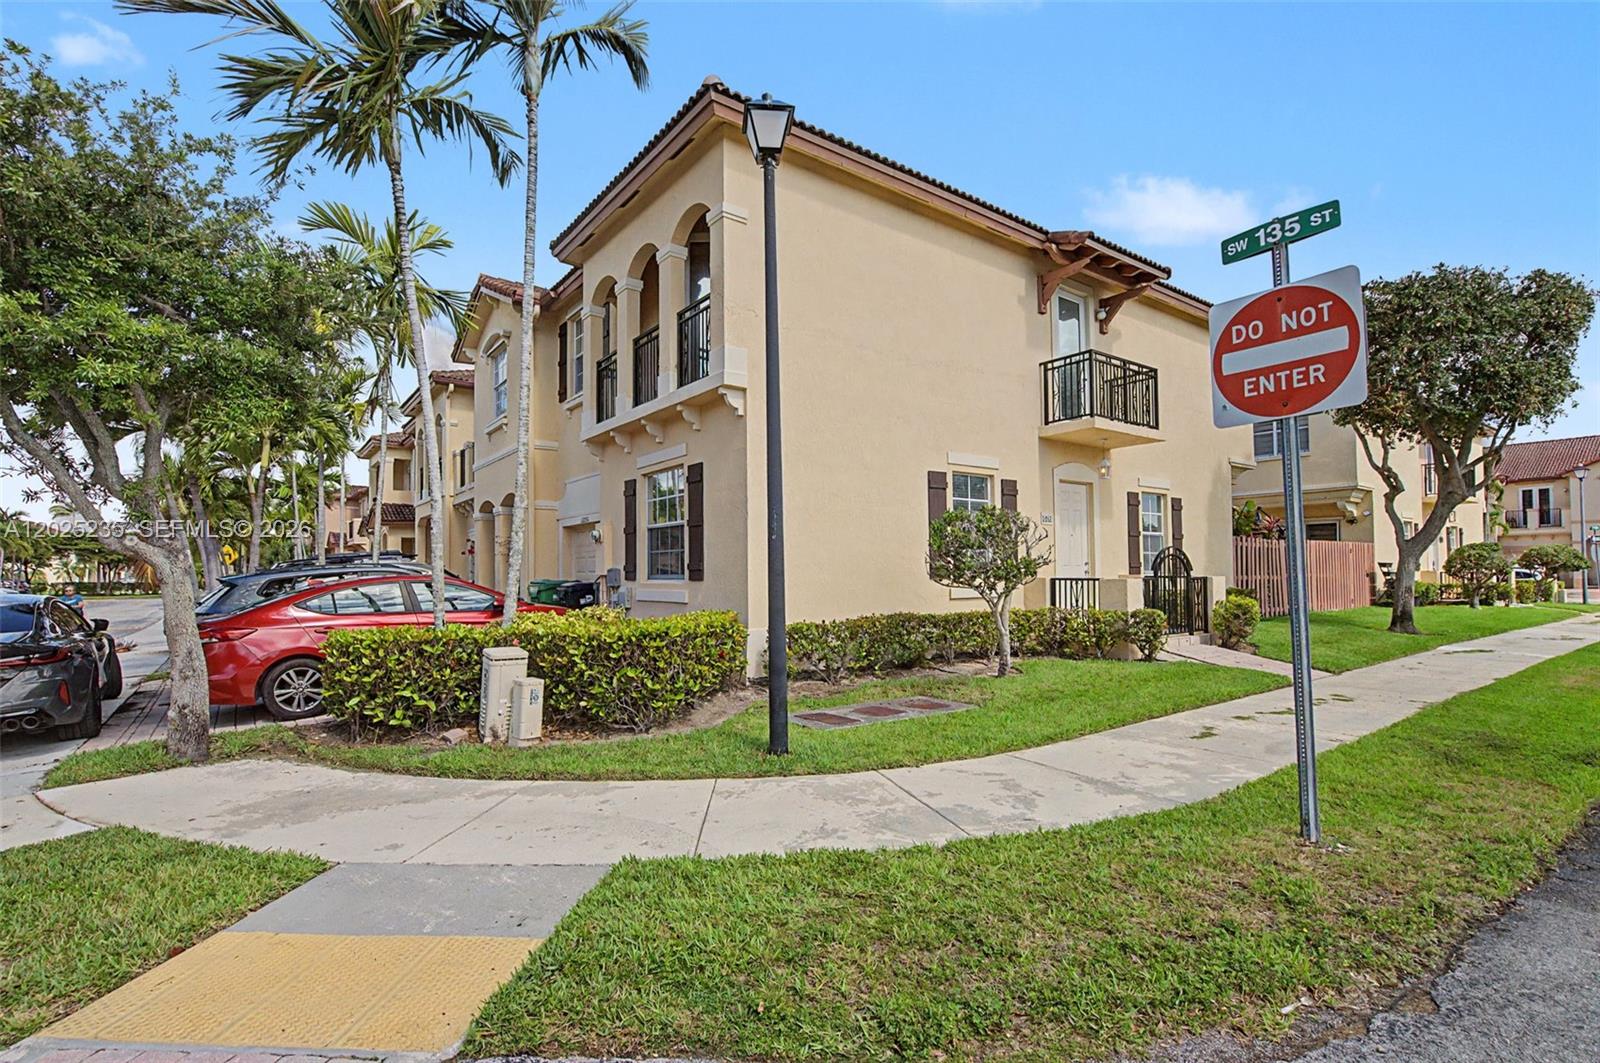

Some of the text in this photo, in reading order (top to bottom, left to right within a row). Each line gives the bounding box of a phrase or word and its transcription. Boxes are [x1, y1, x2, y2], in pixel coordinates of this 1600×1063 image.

[1227, 208, 1333, 256] SW 135 ST
[1231, 300, 1333, 345] DO NOT
[1243, 363, 1326, 398] ENTER
